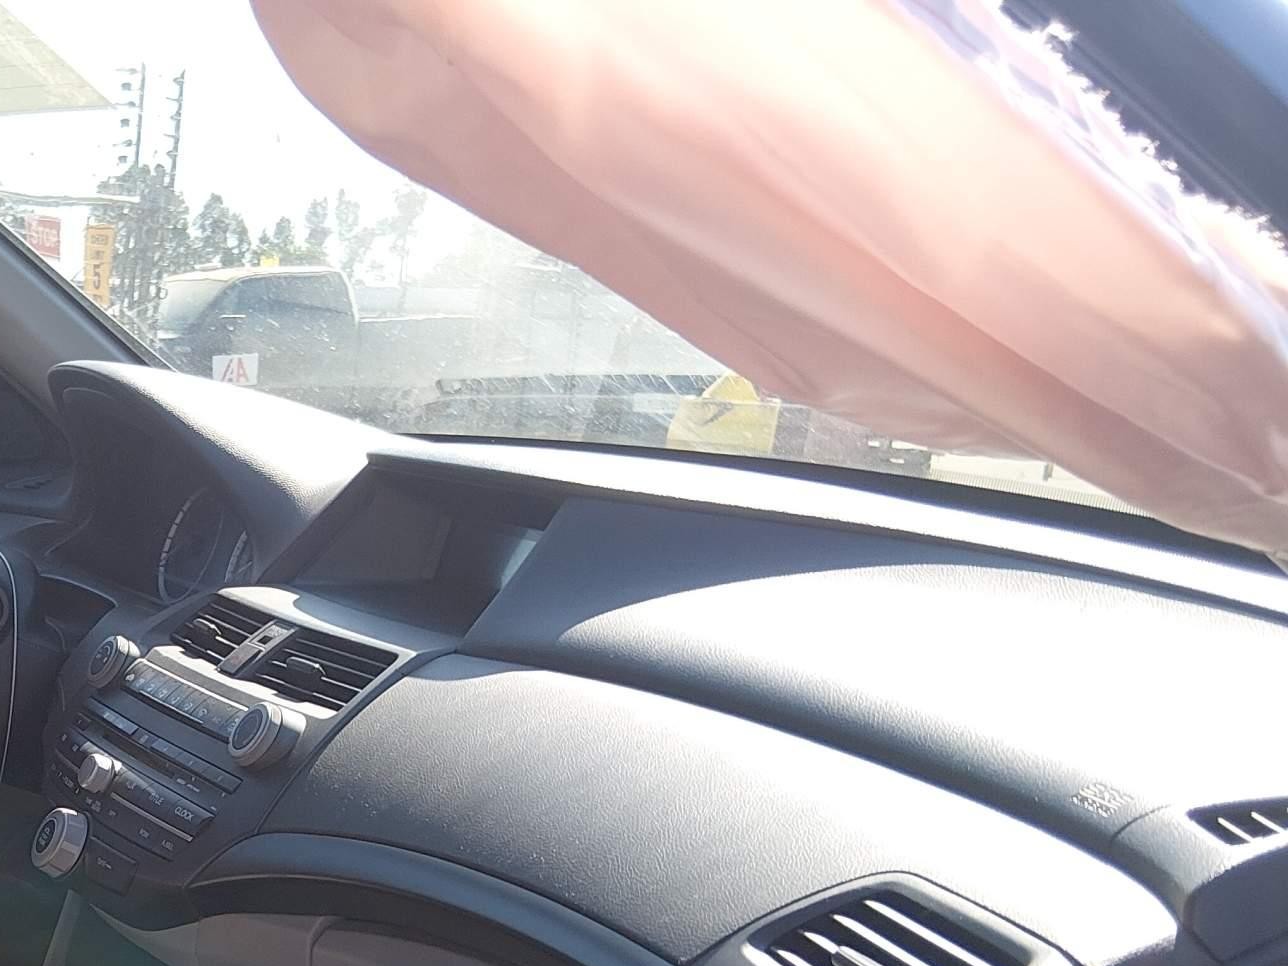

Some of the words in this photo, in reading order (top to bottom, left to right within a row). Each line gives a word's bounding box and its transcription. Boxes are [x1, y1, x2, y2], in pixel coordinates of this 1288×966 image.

[31, 225, 57, 246] STOP
[92, 264, 102, 290] 5
[174, 806, 195, 822] CLOCK
